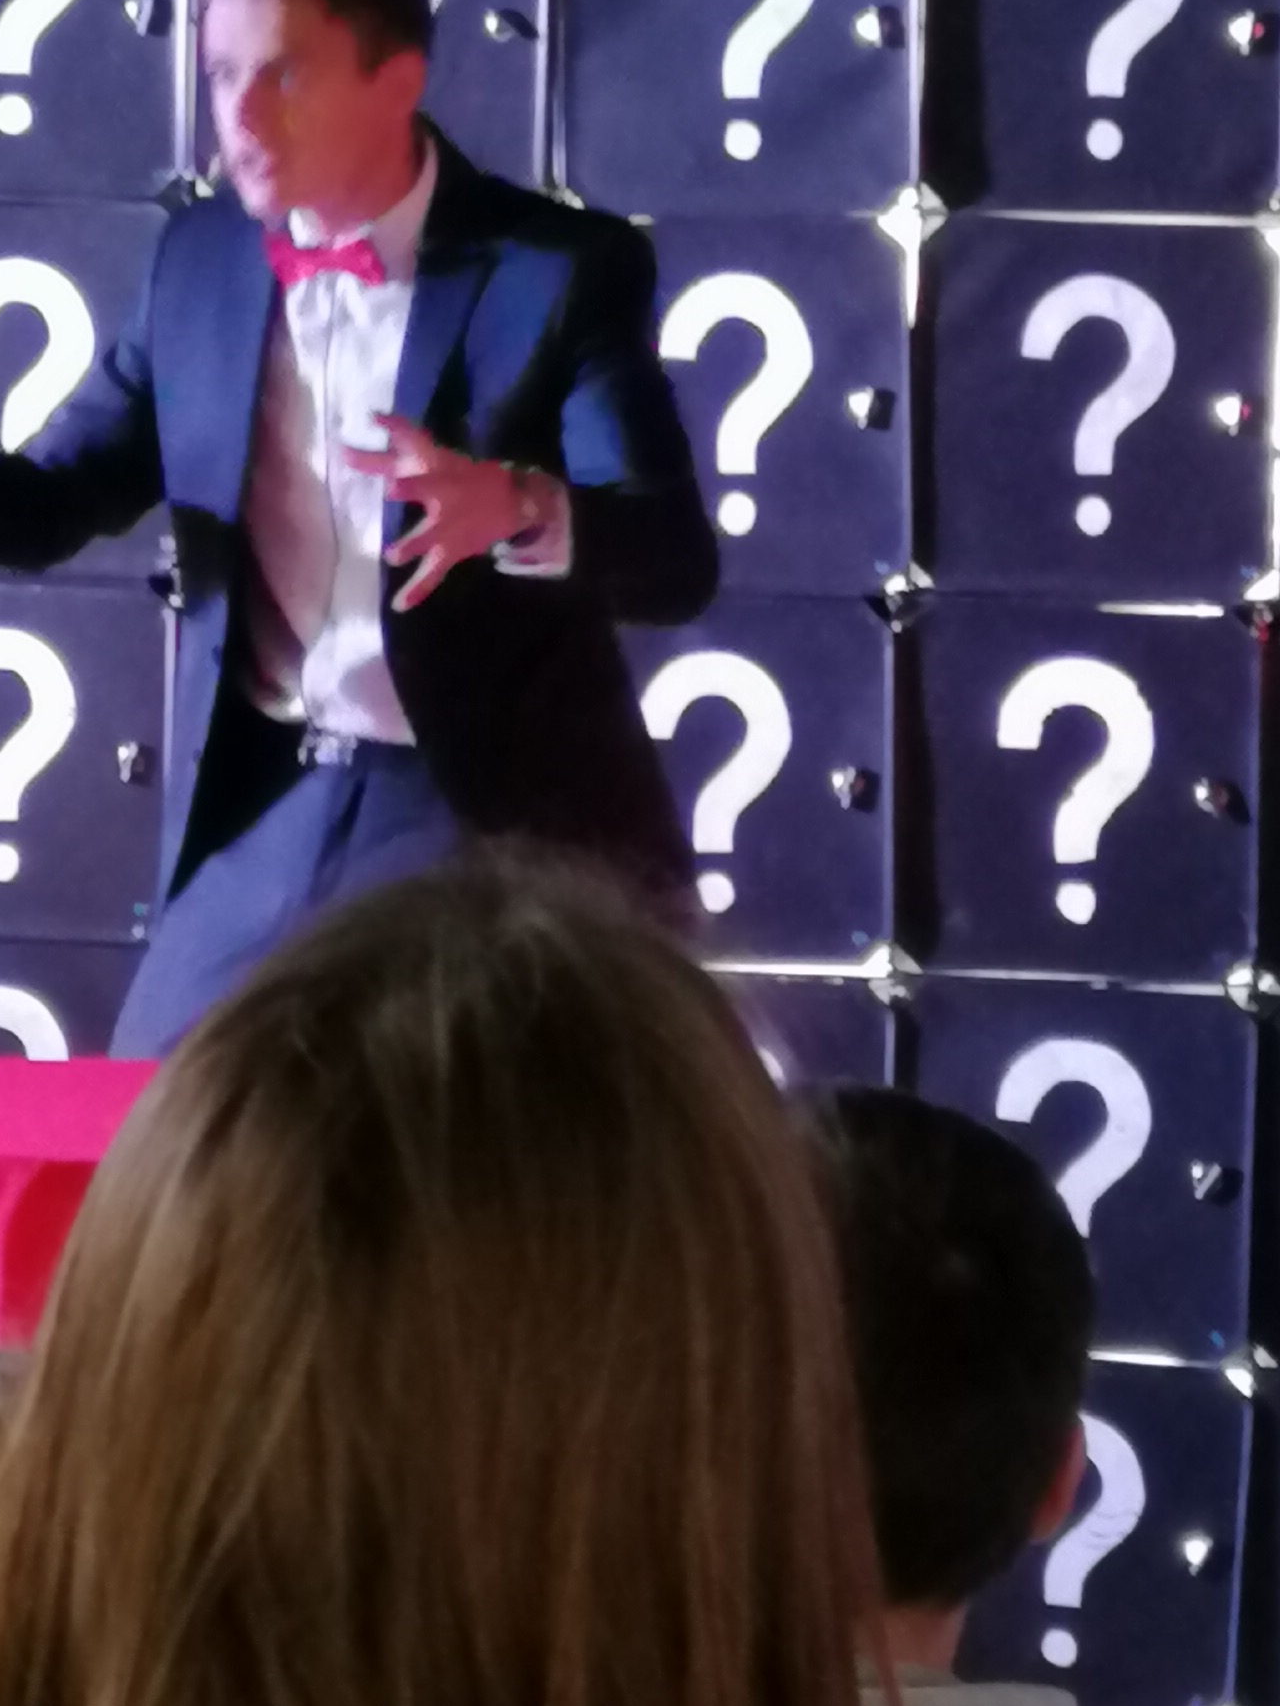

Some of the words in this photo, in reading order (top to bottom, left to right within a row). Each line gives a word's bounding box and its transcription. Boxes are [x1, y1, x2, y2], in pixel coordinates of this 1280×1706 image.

[658, 271, 814, 537] ?
[1021, 274, 1175, 536] ?
[639, 649, 792, 914] ?
[996, 655, 1155, 924] ?
